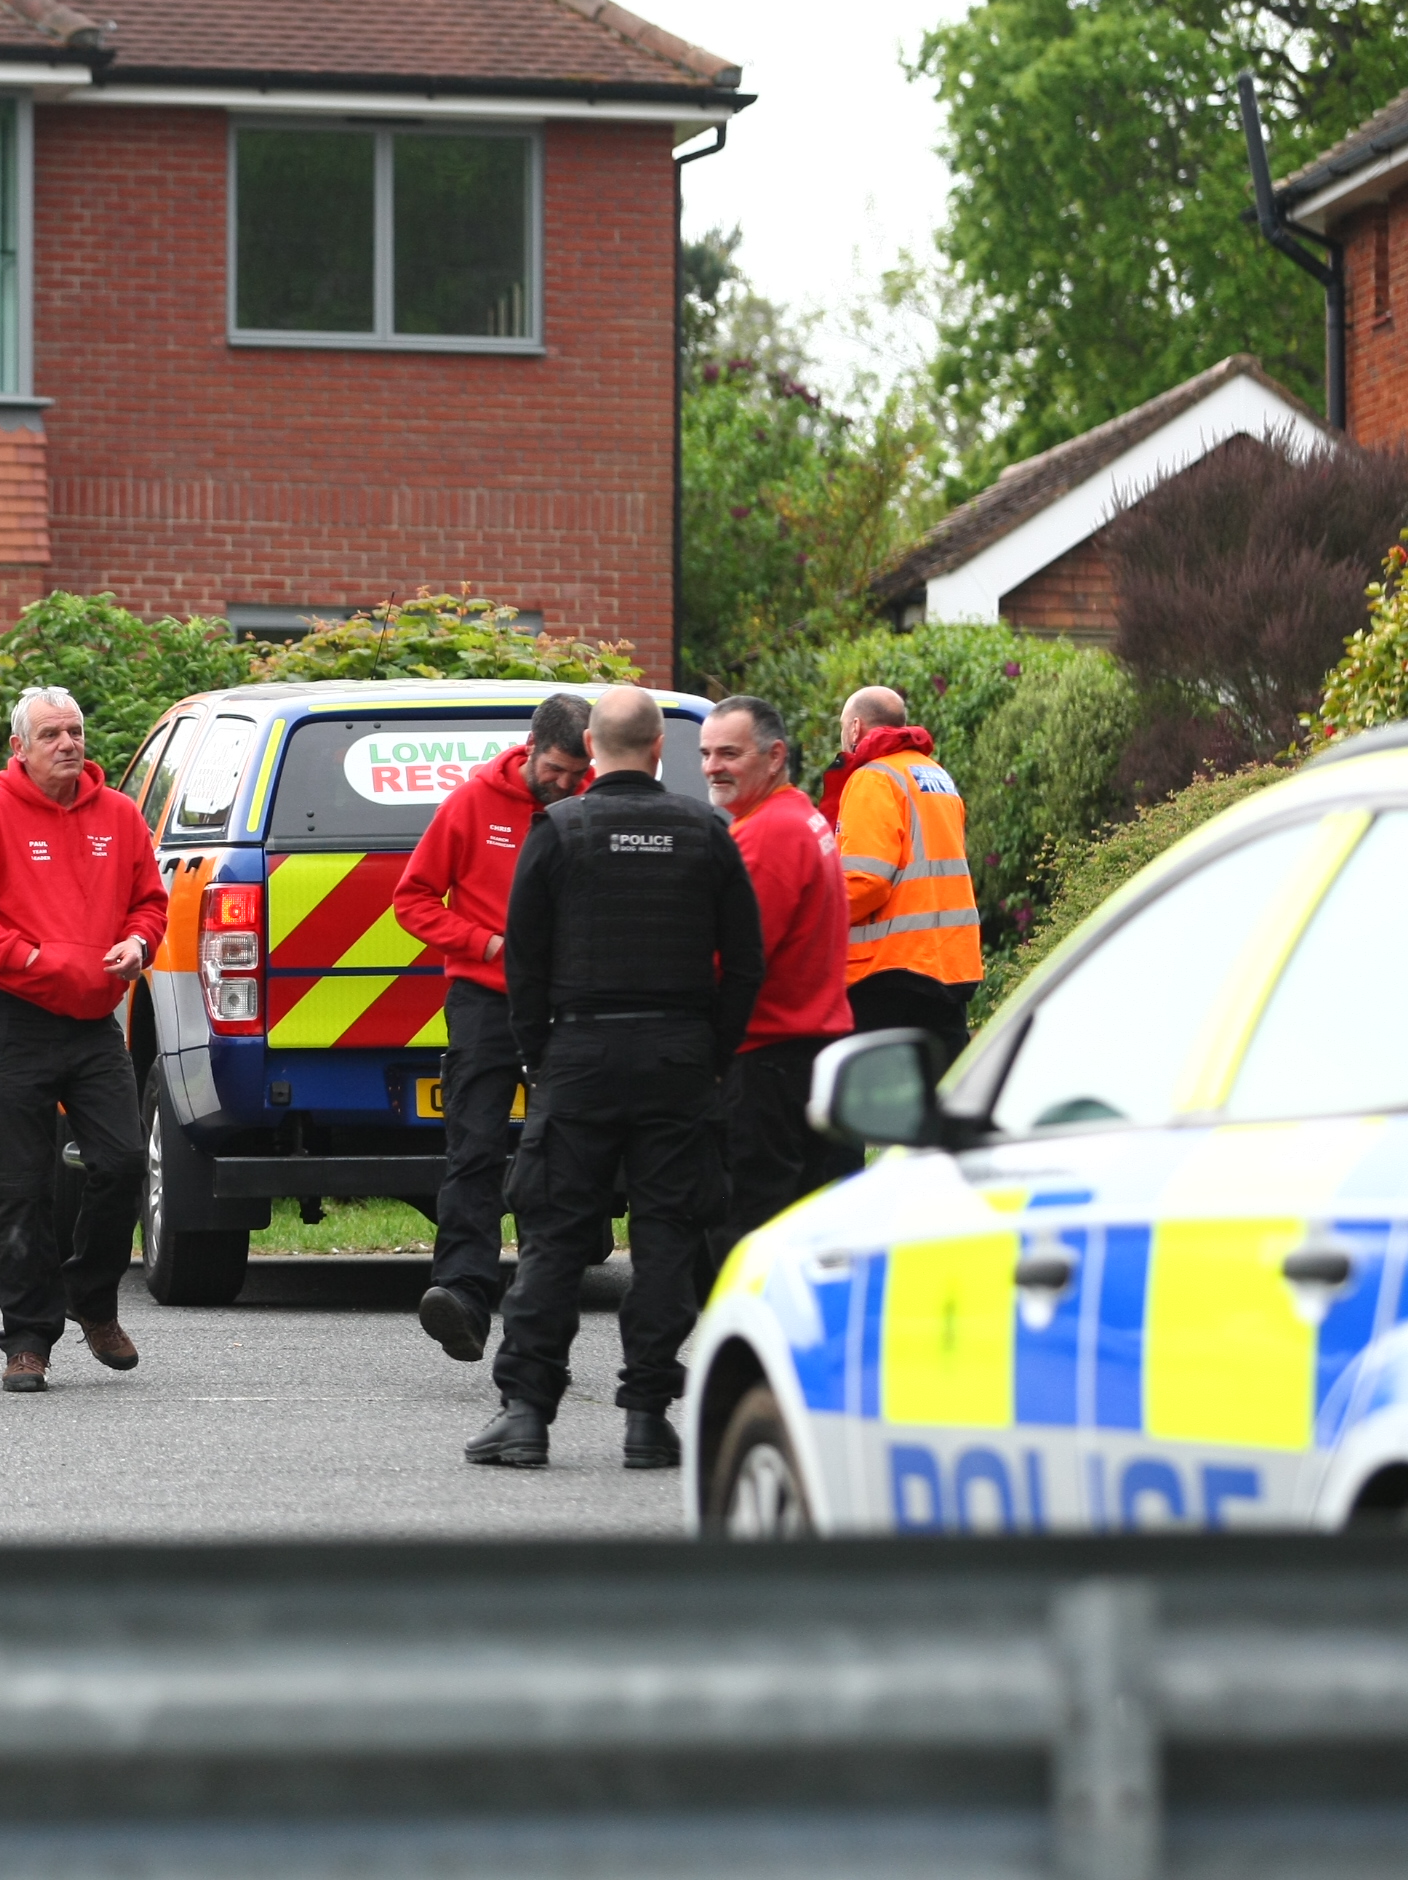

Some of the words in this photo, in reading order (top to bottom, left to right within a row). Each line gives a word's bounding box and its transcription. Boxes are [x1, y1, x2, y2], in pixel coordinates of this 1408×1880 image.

[369, 742, 519, 764] LOWLA
[489, 824, 512, 833] CHRIS
[619, 834, 674, 846] POLICE
